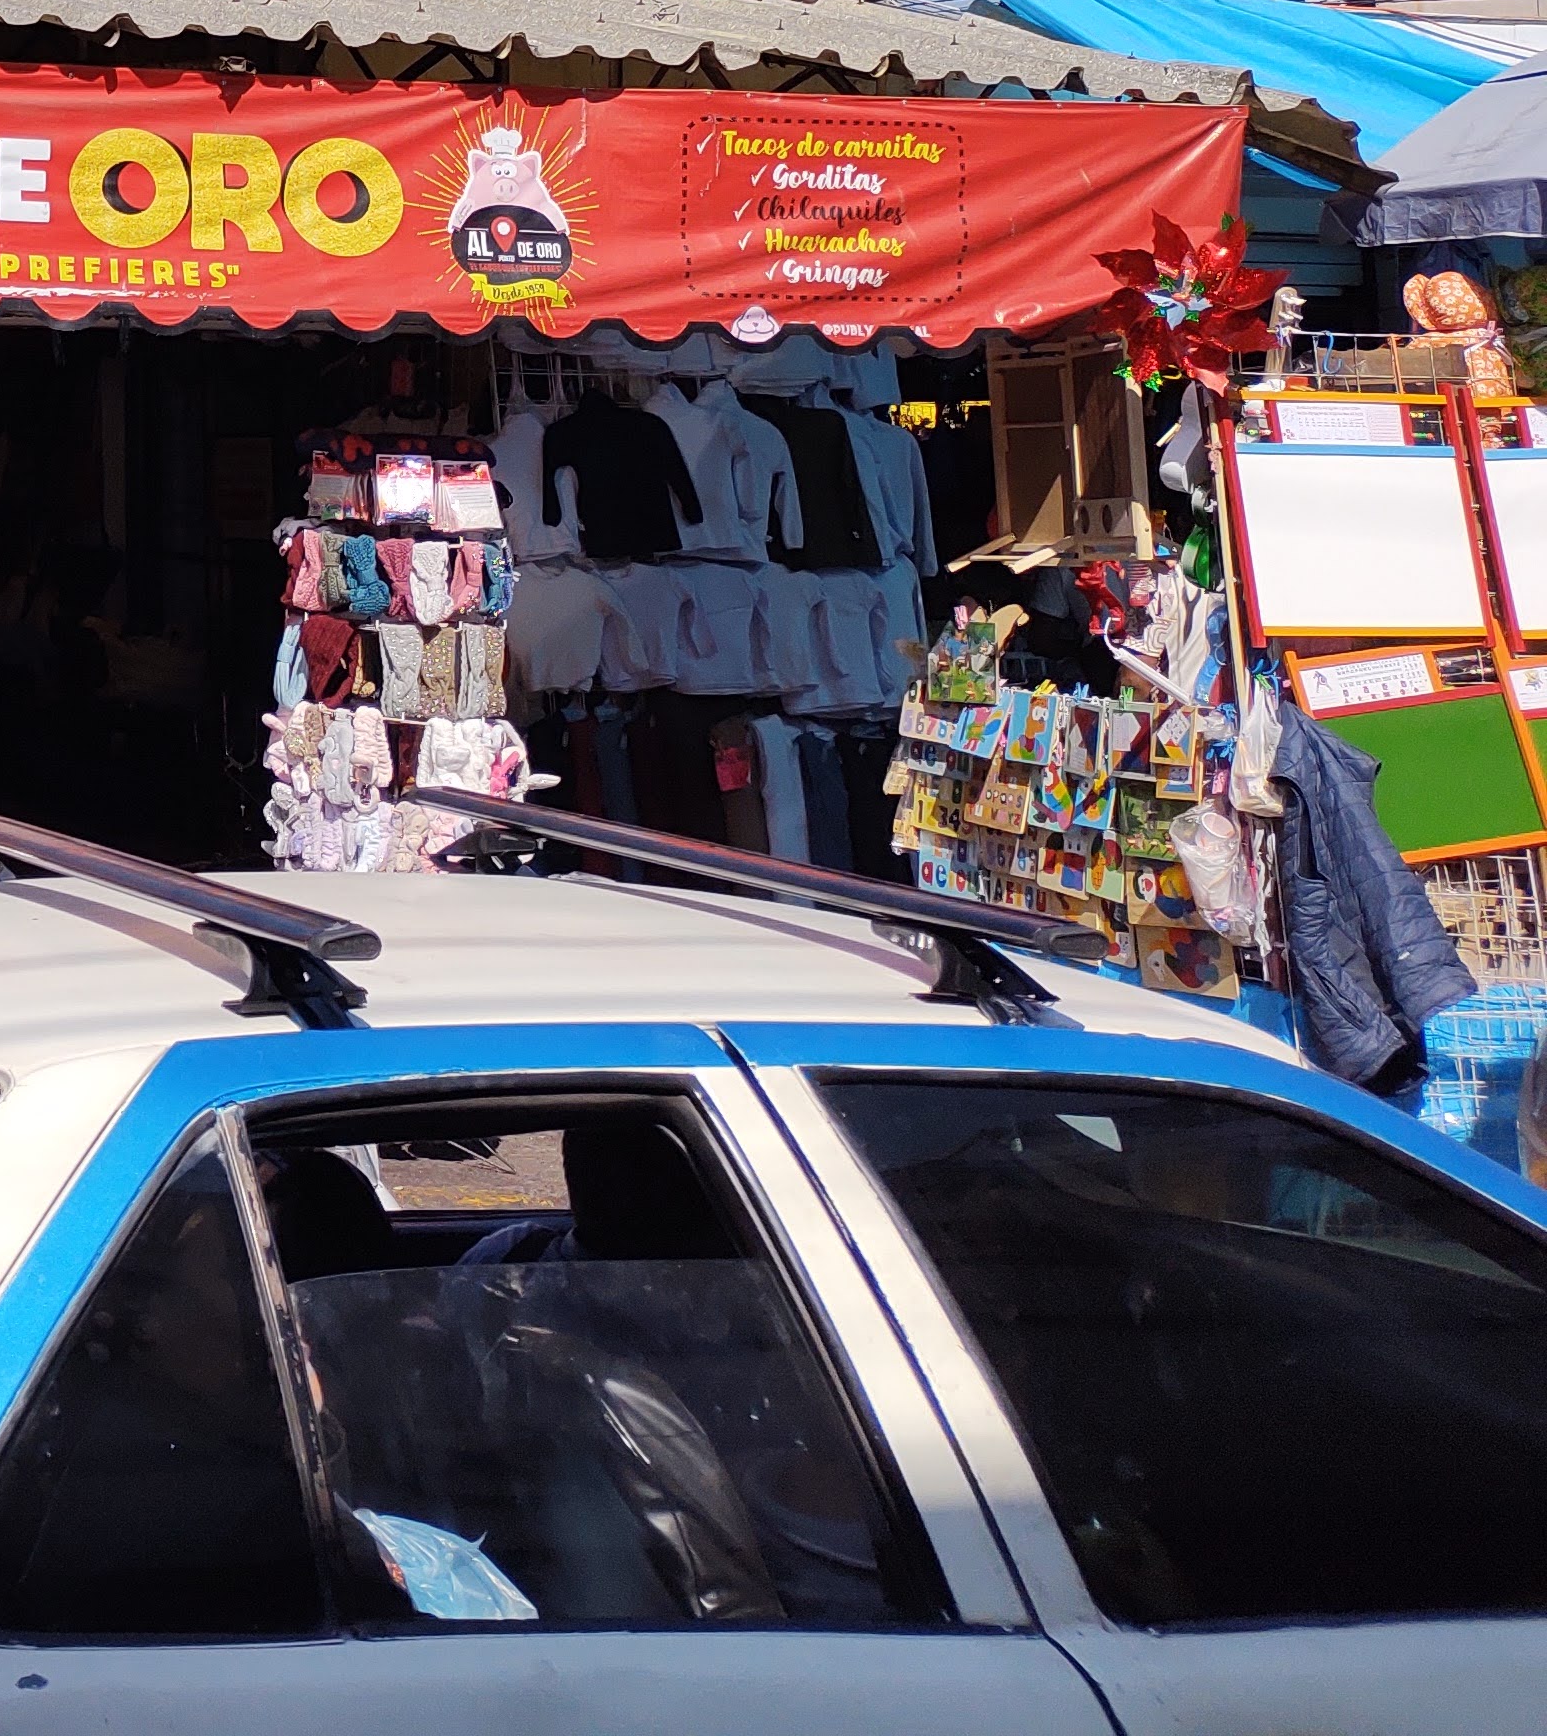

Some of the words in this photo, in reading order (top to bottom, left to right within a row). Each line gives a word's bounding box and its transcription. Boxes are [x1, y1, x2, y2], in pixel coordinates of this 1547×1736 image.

[722, 130, 793, 158] Tacos
[796, 132, 829, 157] de
[833, 132, 946, 163] carnitas
[69, 126, 405, 258] ORO
[773, 163, 887, 194] Gorditas
[757, 195, 906, 229] Chilaquiles
[467, 230, 494, 257] AL
[517, 241, 535, 258] DE
[536, 242, 562, 259] ORO
[765, 228, 907, 256] Huaraches
[0, 254, 240, 290] PREFIERES"
[782, 259, 890, 291] Gringas
